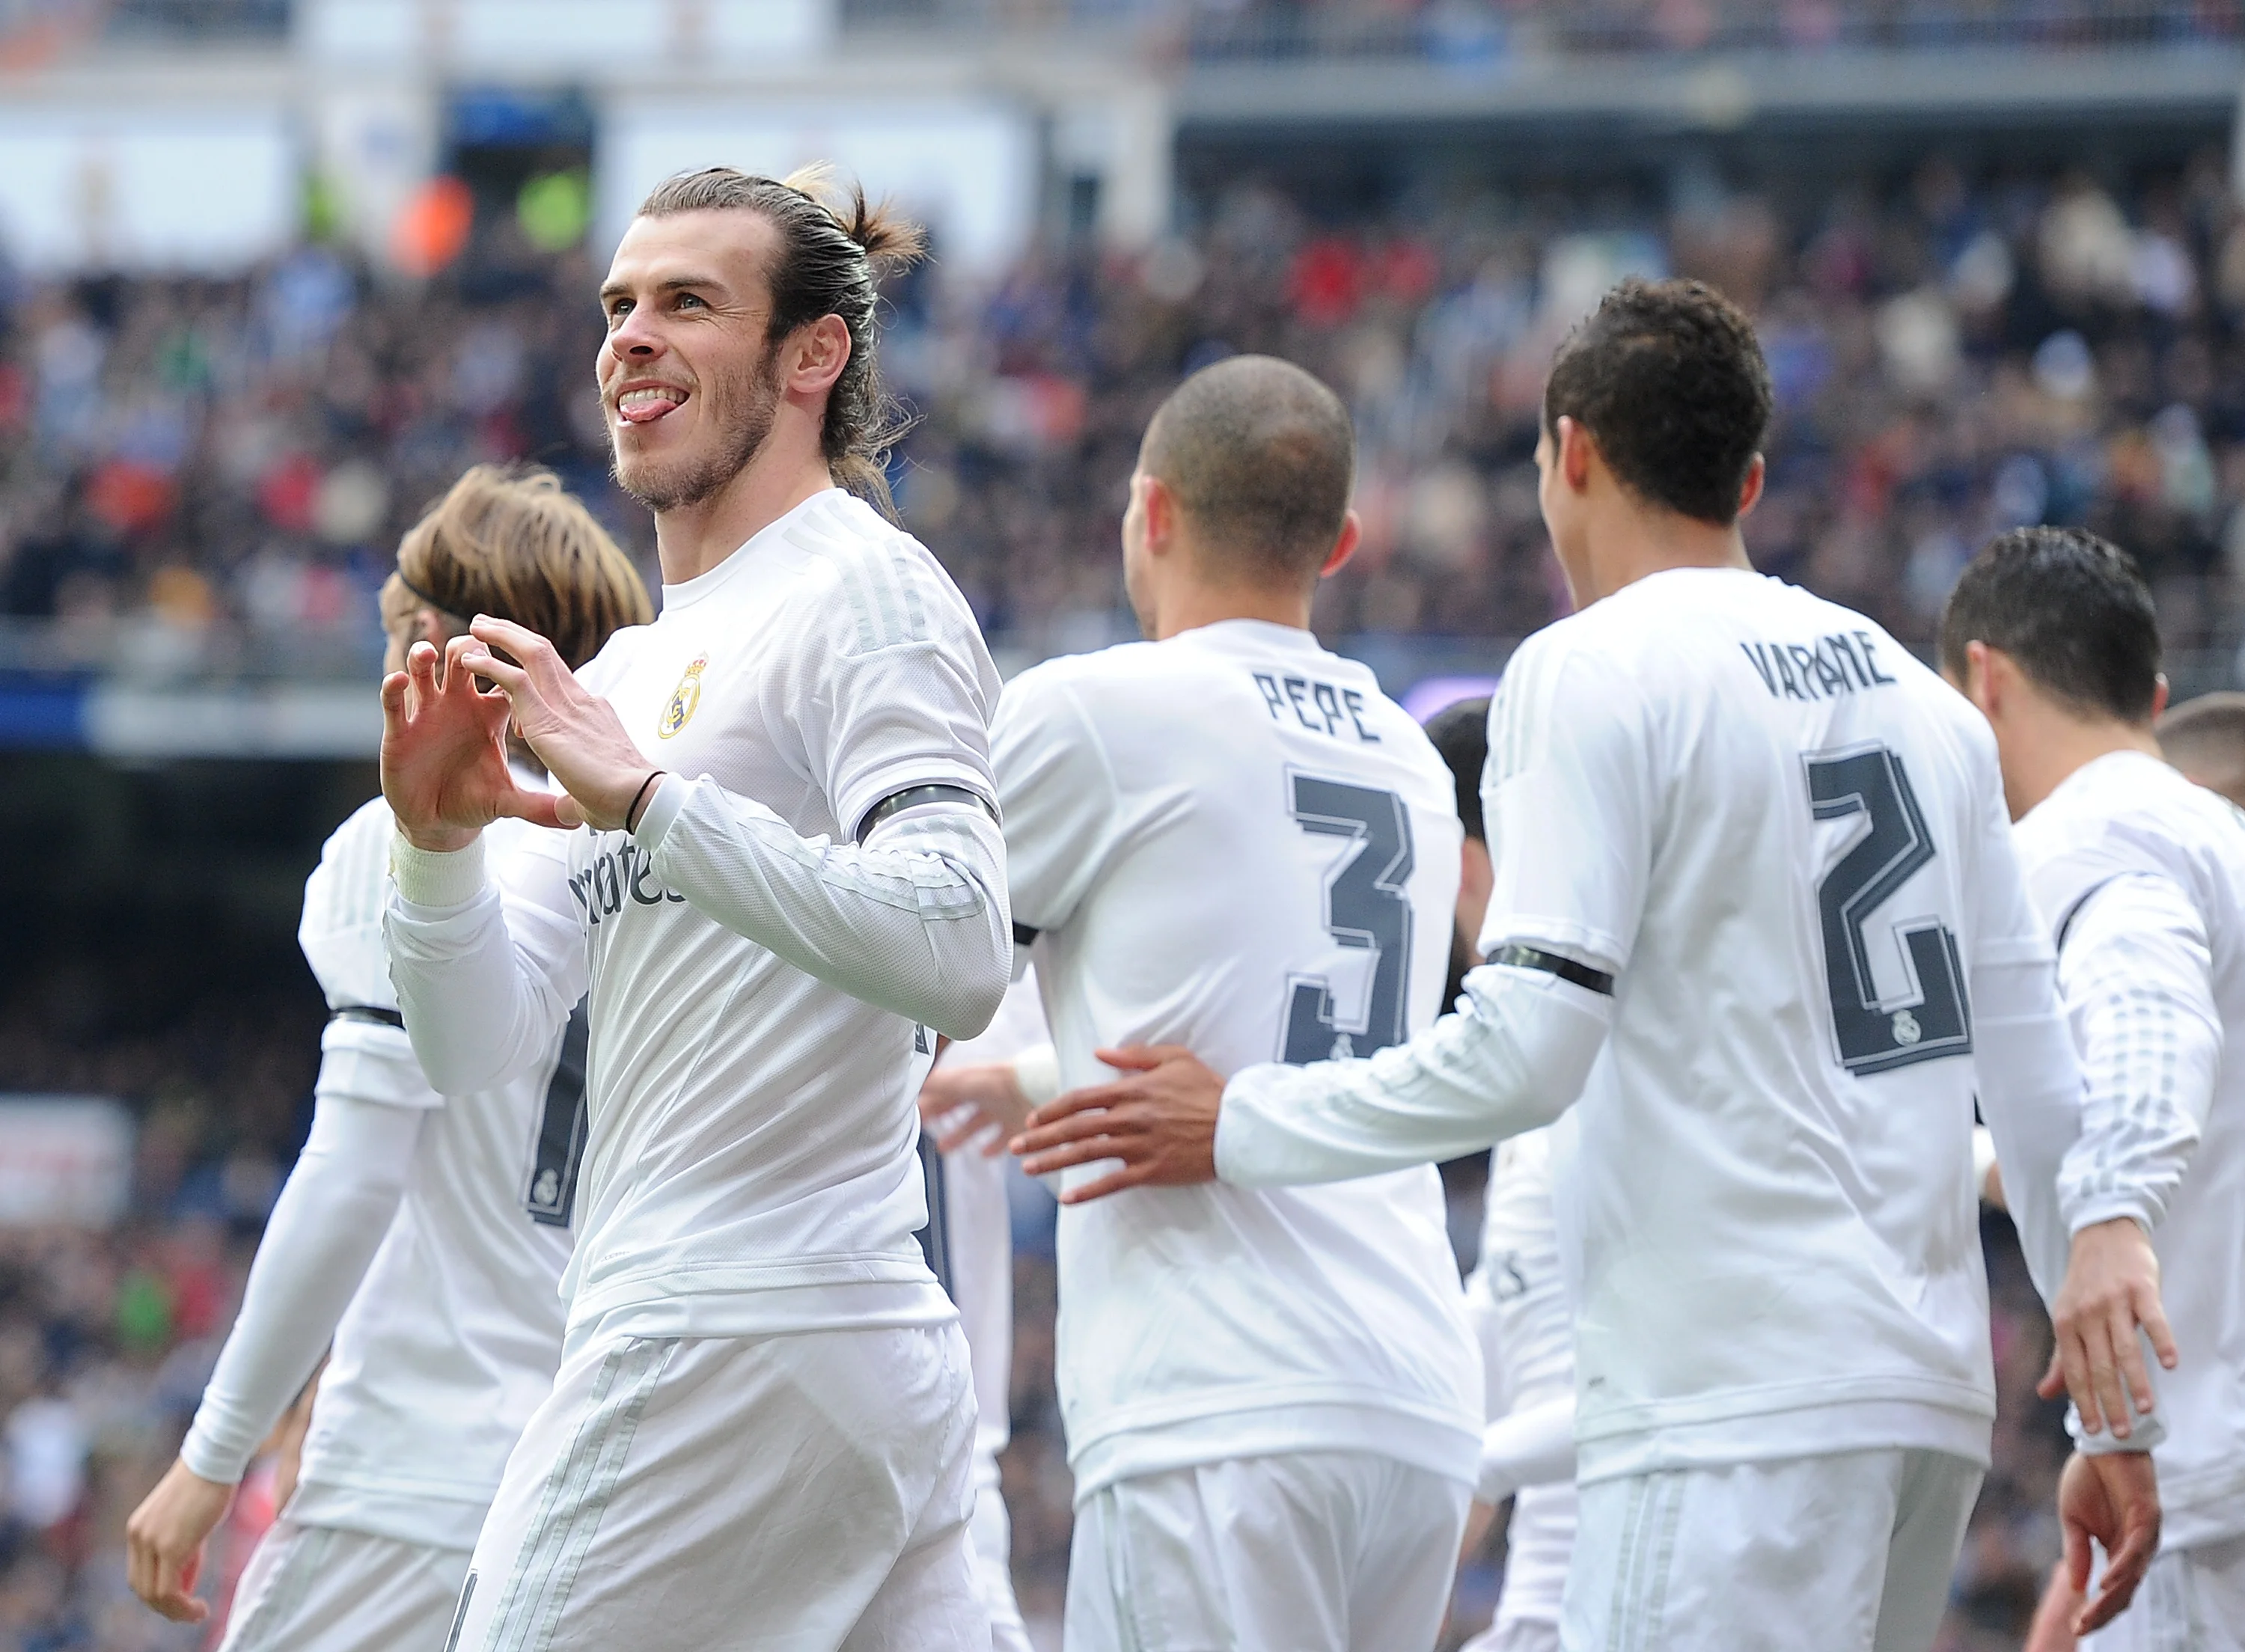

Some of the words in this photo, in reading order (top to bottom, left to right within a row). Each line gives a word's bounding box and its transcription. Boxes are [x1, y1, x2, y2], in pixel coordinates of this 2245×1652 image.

[1252, 673, 1380, 742] PEPE
[1740, 631, 1896, 700] VARANE
[1274, 763, 1416, 1062] 3
[1800, 738, 1974, 1076] 2
